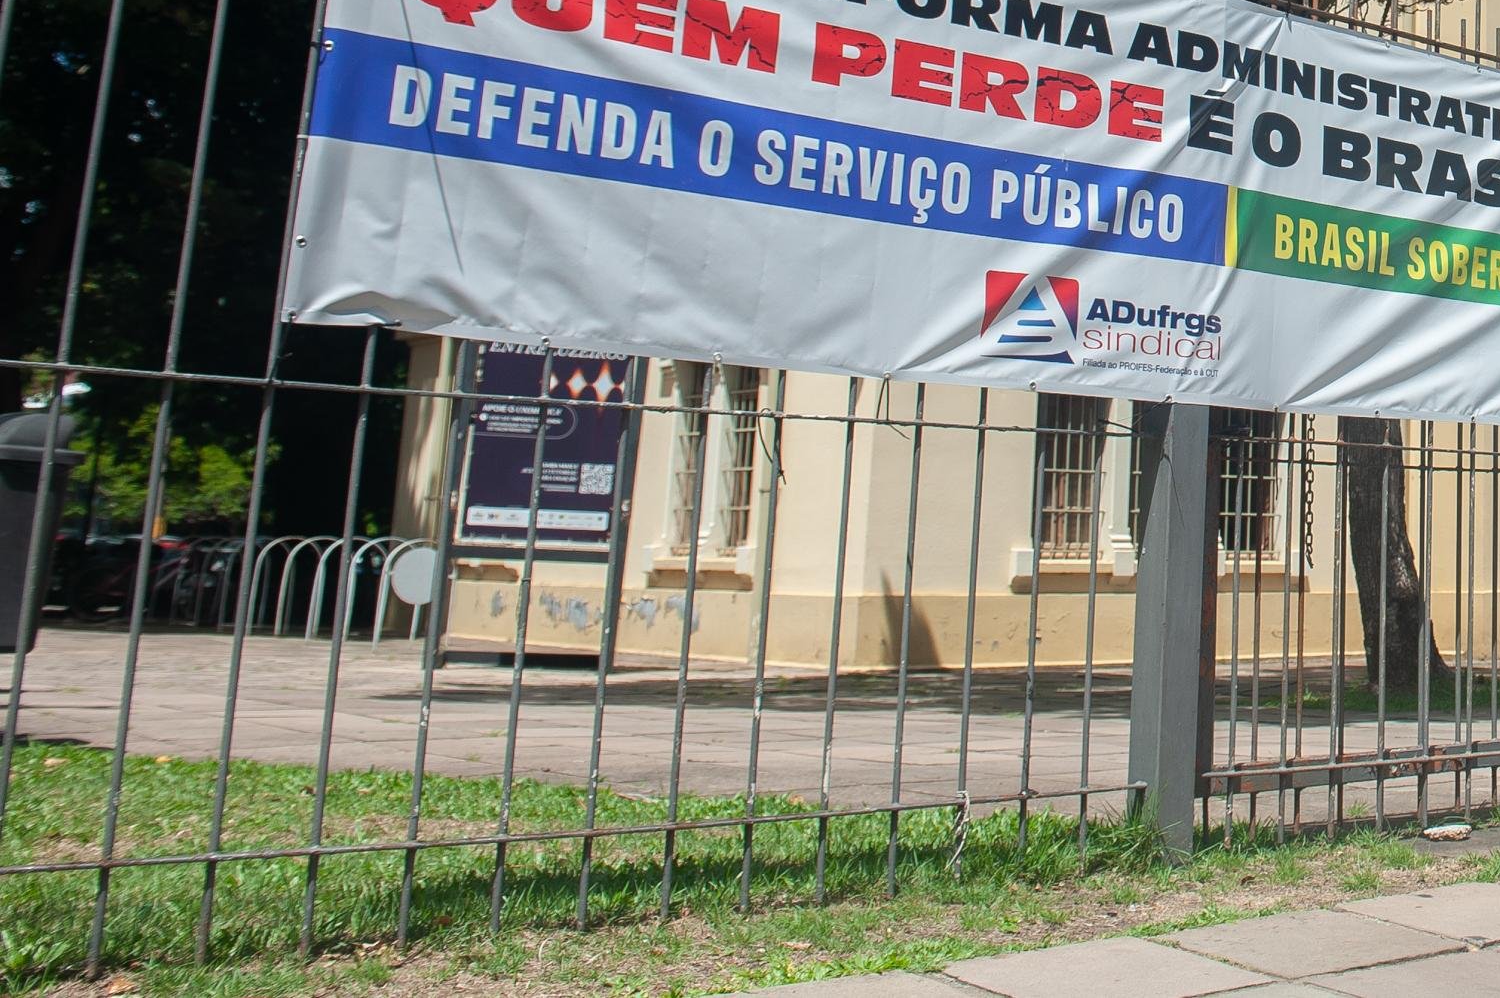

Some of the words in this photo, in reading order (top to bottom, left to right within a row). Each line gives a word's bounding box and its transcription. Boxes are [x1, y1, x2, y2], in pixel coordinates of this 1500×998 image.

[811, 21, 1165, 142] PERDE
[1187, 90, 1234, 156] É
[1251, 111, 1301, 169] O
[388, 65, 674, 169] DEFENDA
[698, 119, 735, 177] O
[754, 129, 971, 224] SERVIÇO
[991, 163, 1184, 242] PÚBLICO
[1274, 214, 1396, 277] BRASIL
[1083, 325, 1222, 361] sindical
[1086, 298, 1222, 337] ADufrgs
[1082, 358, 1107, 369] Filiada
[1205, 369, 1219, 378] CUT
